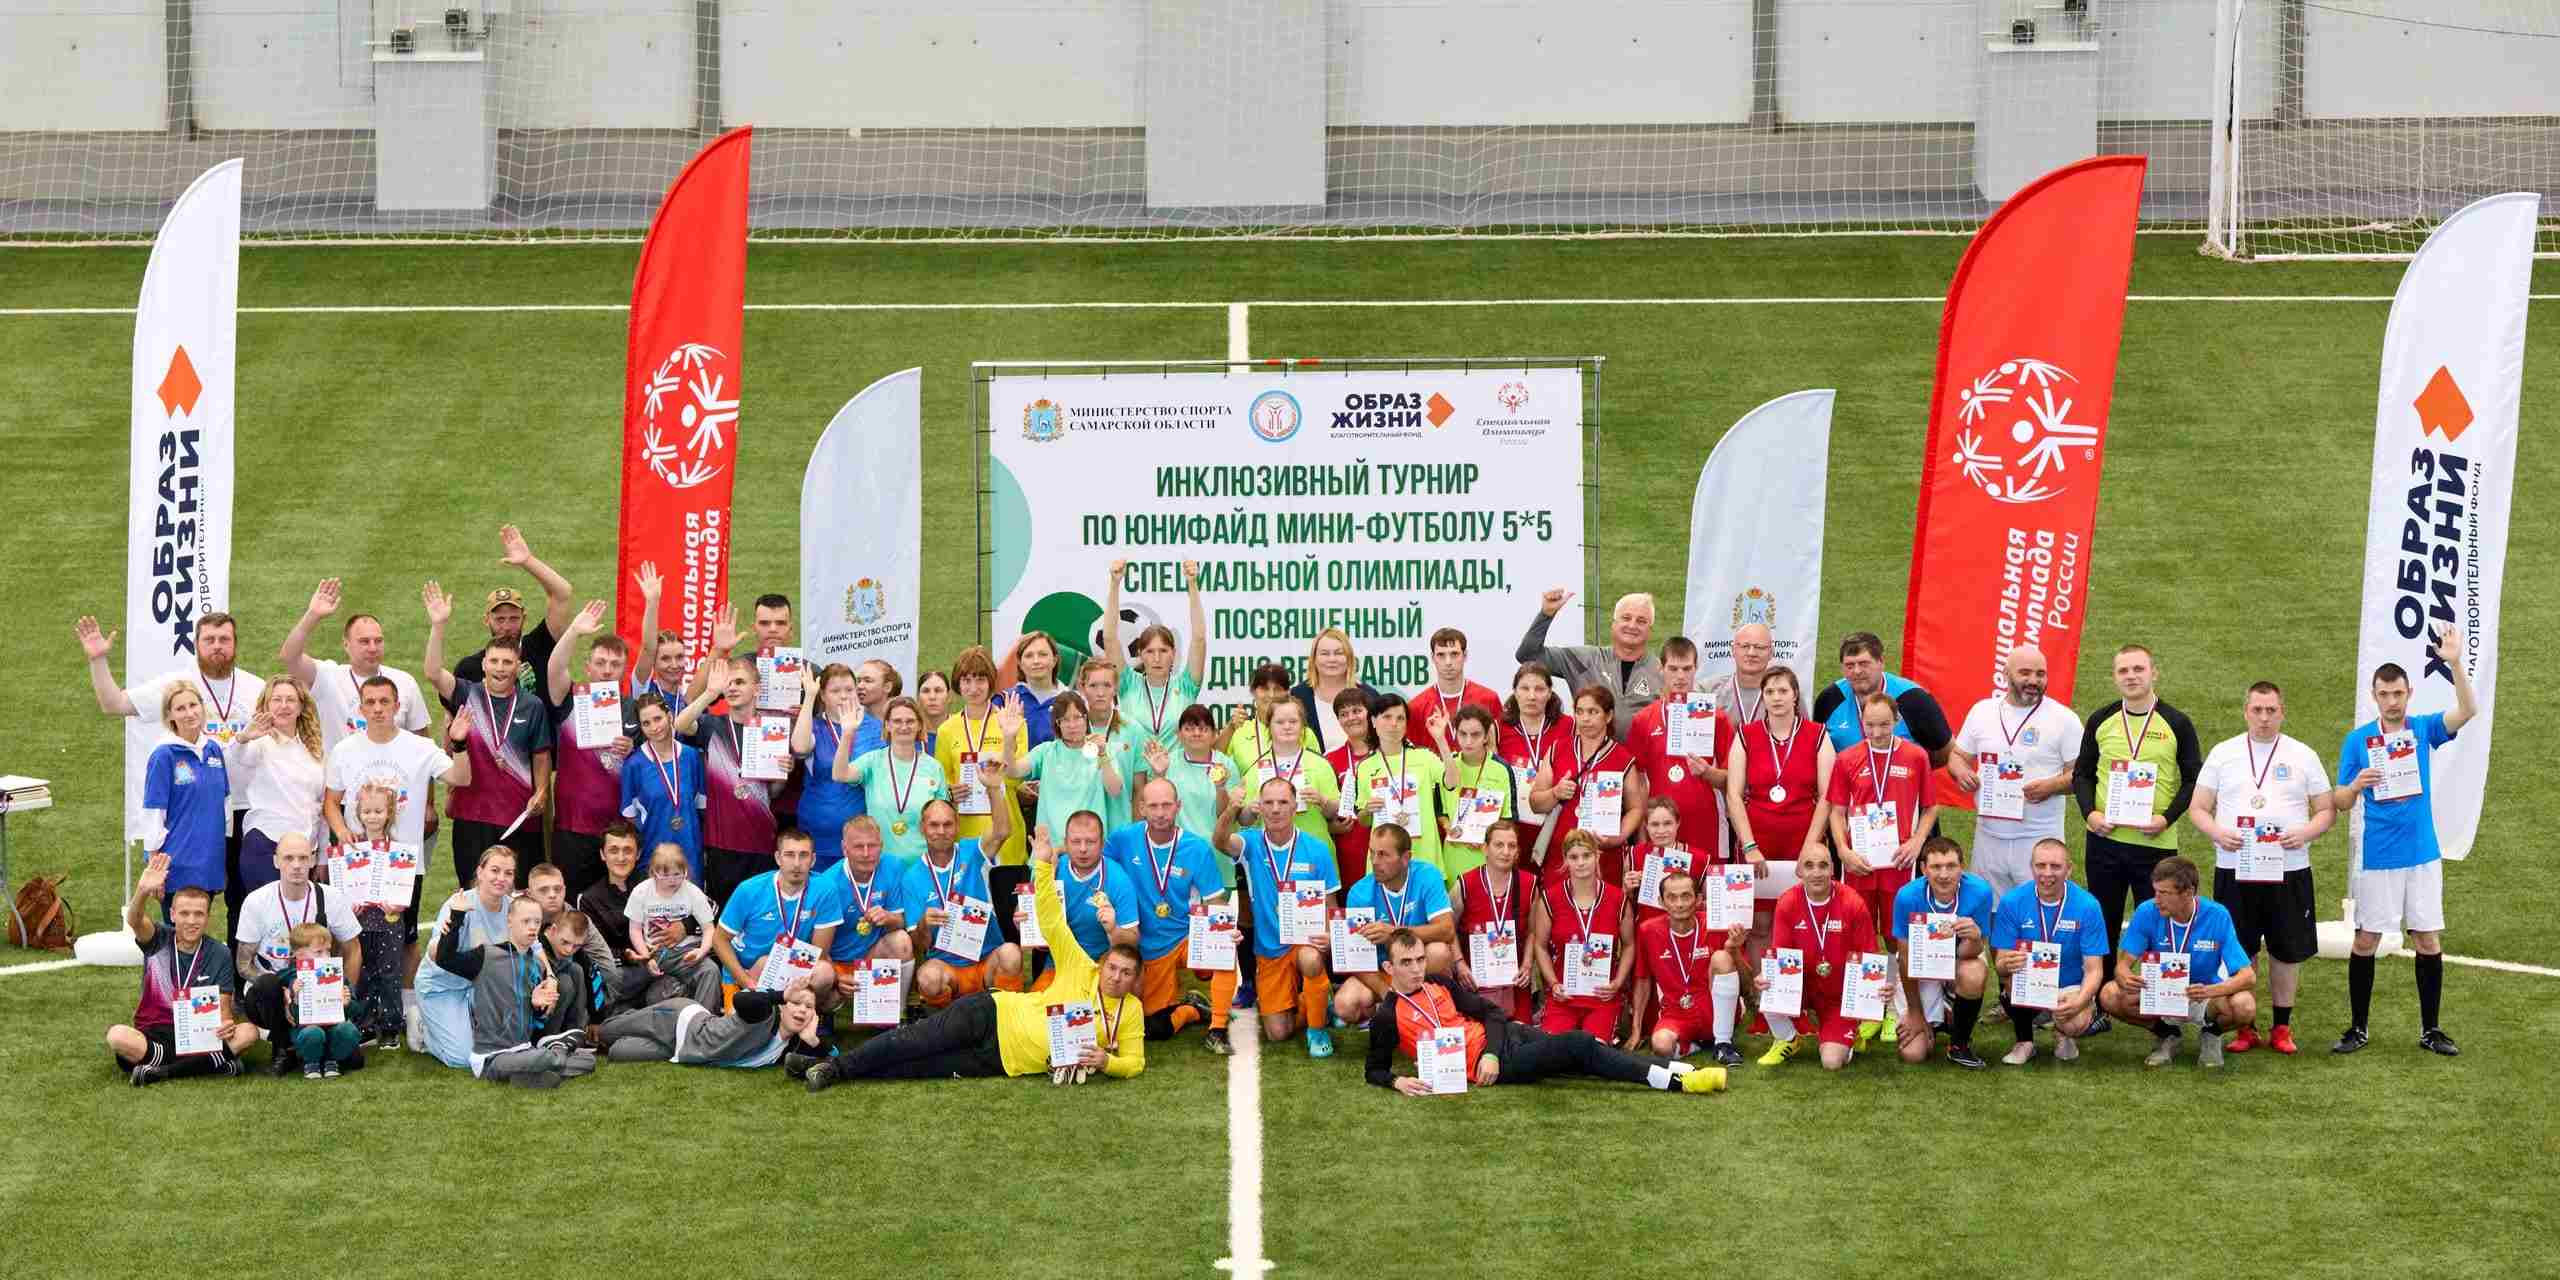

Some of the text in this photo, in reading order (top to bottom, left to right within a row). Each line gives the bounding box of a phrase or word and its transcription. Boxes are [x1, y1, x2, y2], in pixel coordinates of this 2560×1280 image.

[1069, 418, 1215, 431] САМАРСКОЙ ОБЛАСТИ
[1070, 405, 1232, 417] МИНИСТЕРСТВО СПОРТА
[1330, 411, 1422, 429] ЖИЗНИ
[1344, 392, 1422, 411] ОБРАЗ
[1156, 458, 1479, 498] ИНКЛЮЗИВНЫЙ ТУРНИР
[151, 430, 177, 625] ОБРАЗ
[172, 429, 200, 657] ЖИЗНИ
[1083, 514, 1117, 546] ПО
[1125, 507, 1269, 548] ЮНИФАЙД
[1277, 511, 1495, 544] МИНИ-ФУТБОЛУ
[2394, 446, 2435, 640] ОБРАЗ
[681, 511, 700, 696] пециальная
[1327, 558, 1512, 594] ОЛИМПИАДЫ,
[2048, 532, 2080, 630] России
[2424, 452, 2469, 686] ЖИЗНИ
[2466, 511, 2481, 678] ЛАГОТВОРИТЕЛЬНЫЙ
